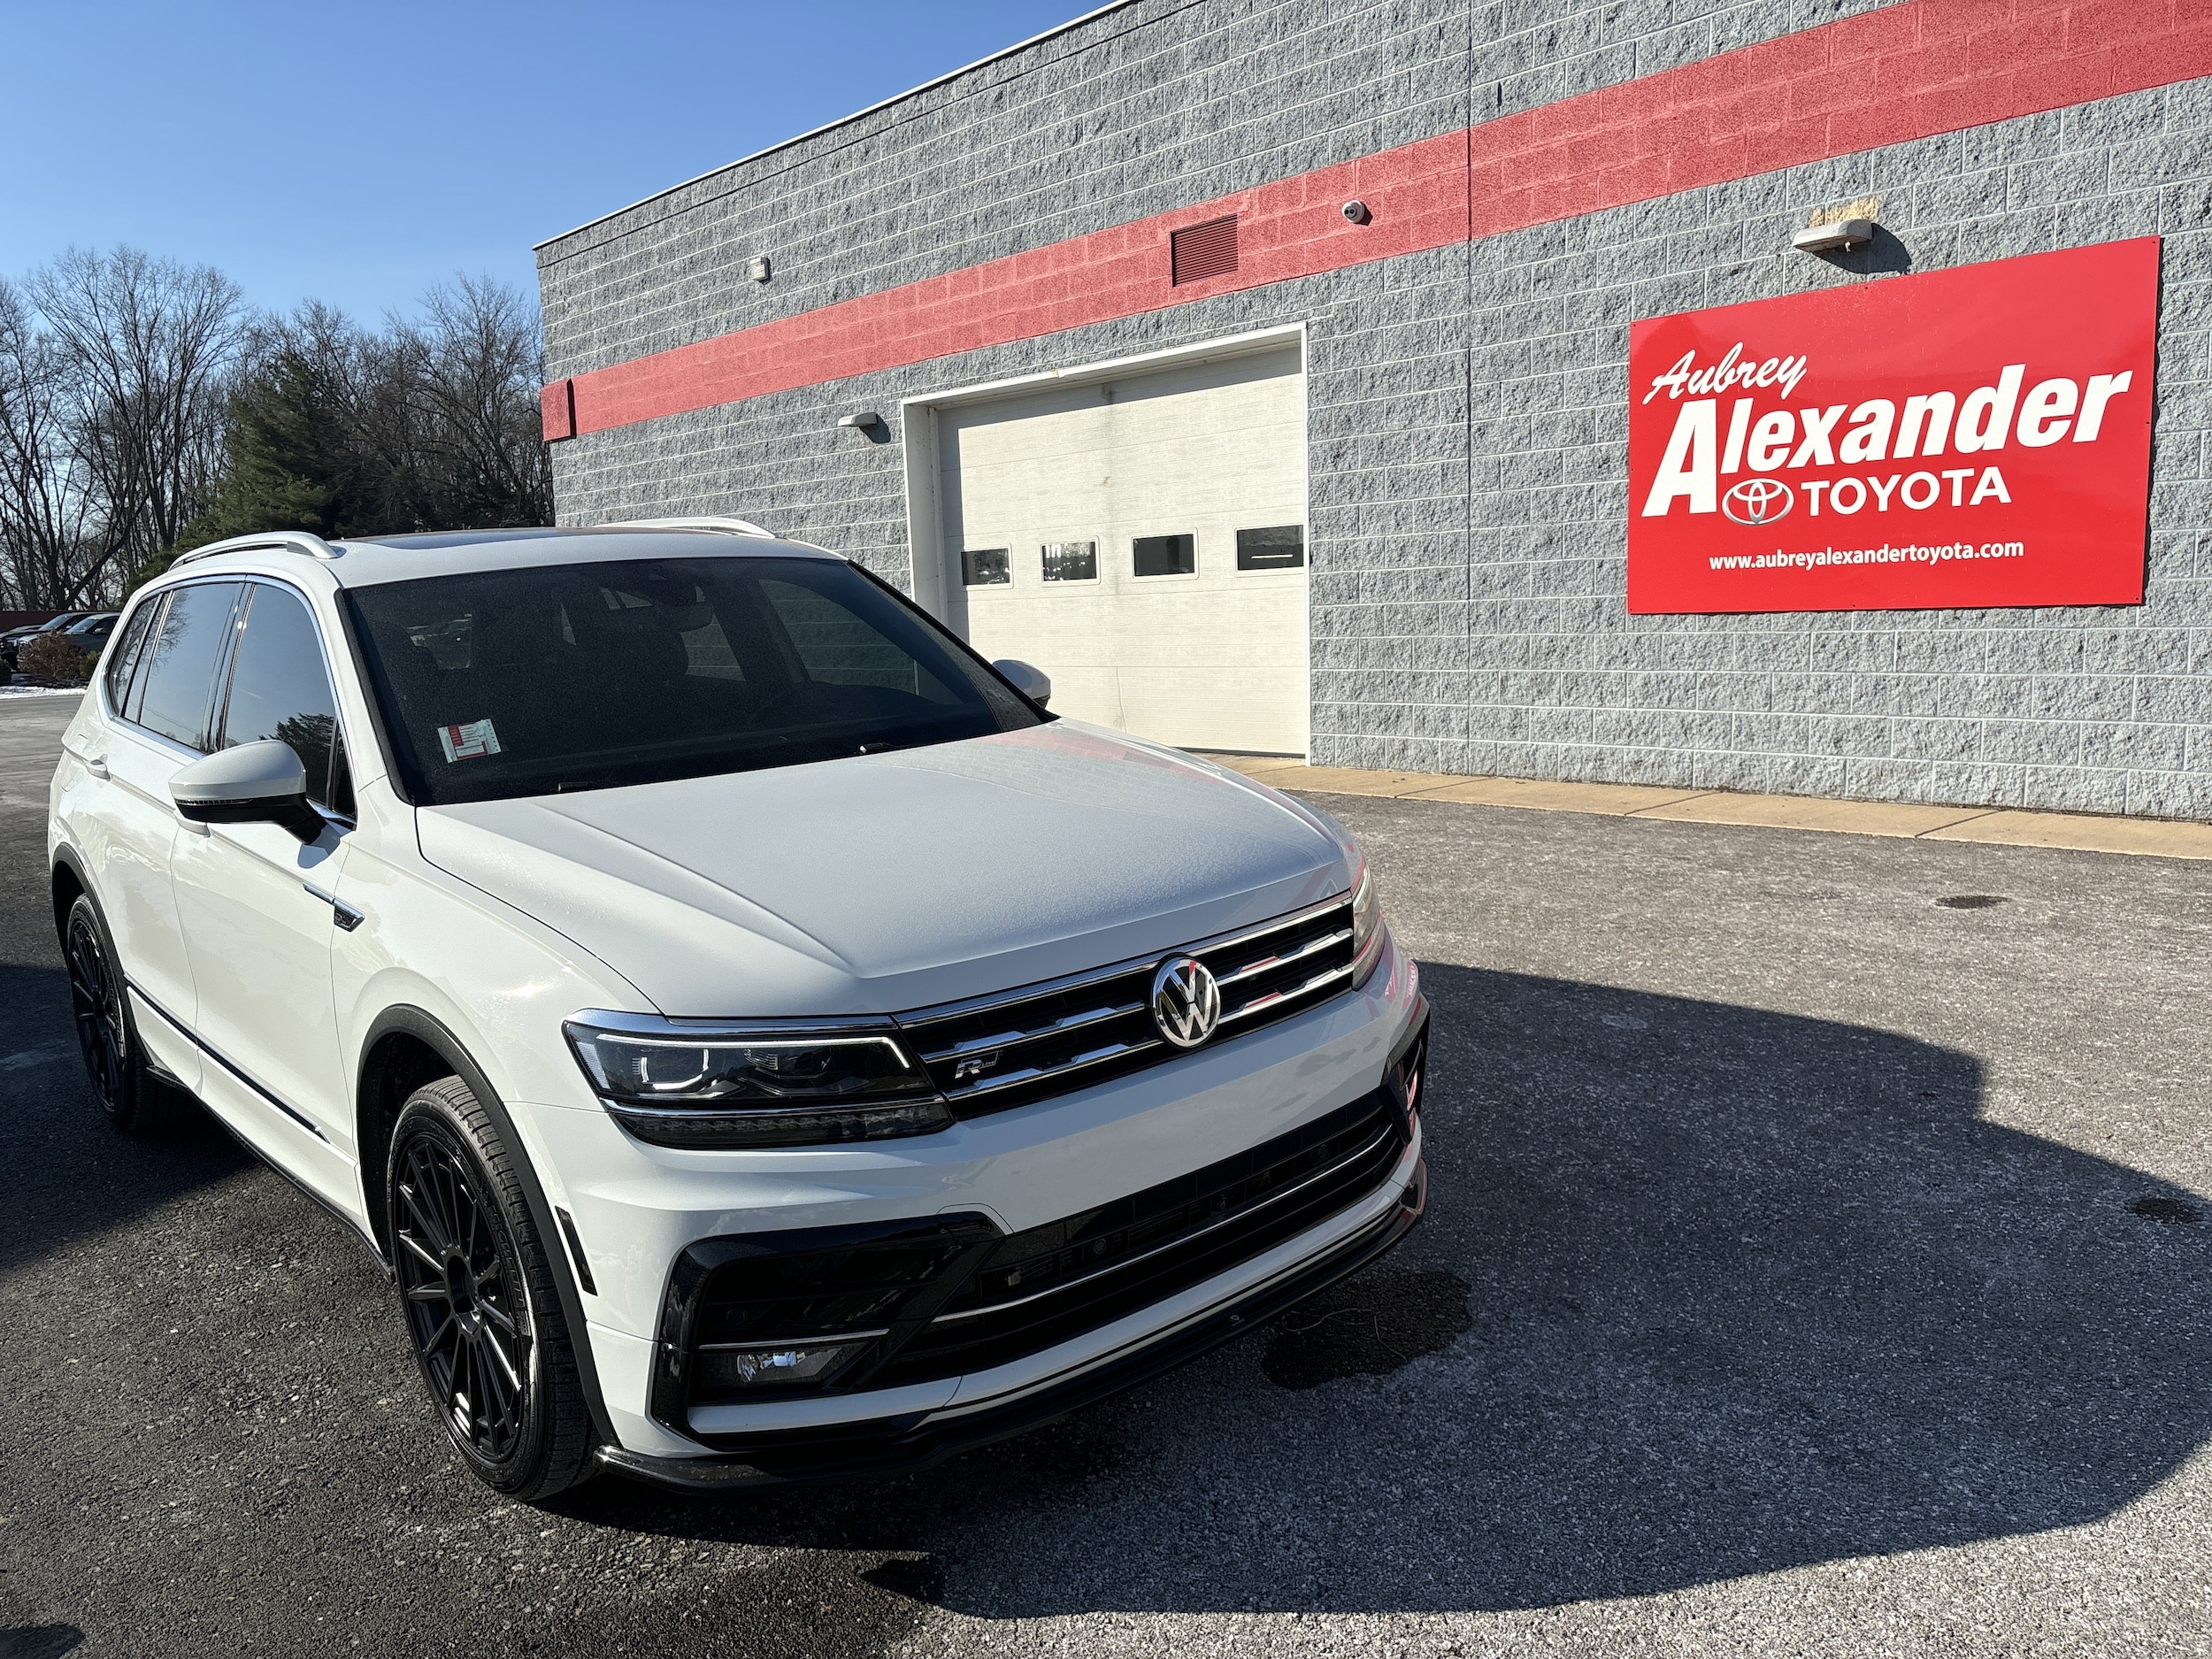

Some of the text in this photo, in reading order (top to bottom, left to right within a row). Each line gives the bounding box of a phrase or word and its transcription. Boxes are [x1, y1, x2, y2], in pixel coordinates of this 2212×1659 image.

[1642, 342, 1808, 405] Aubrey
[1641, 364, 2133, 518] Alexander
[1801, 465, 2012, 517] TOYOTA
[1709, 541, 2025, 572] www.aubreyalexandertoyota.com
